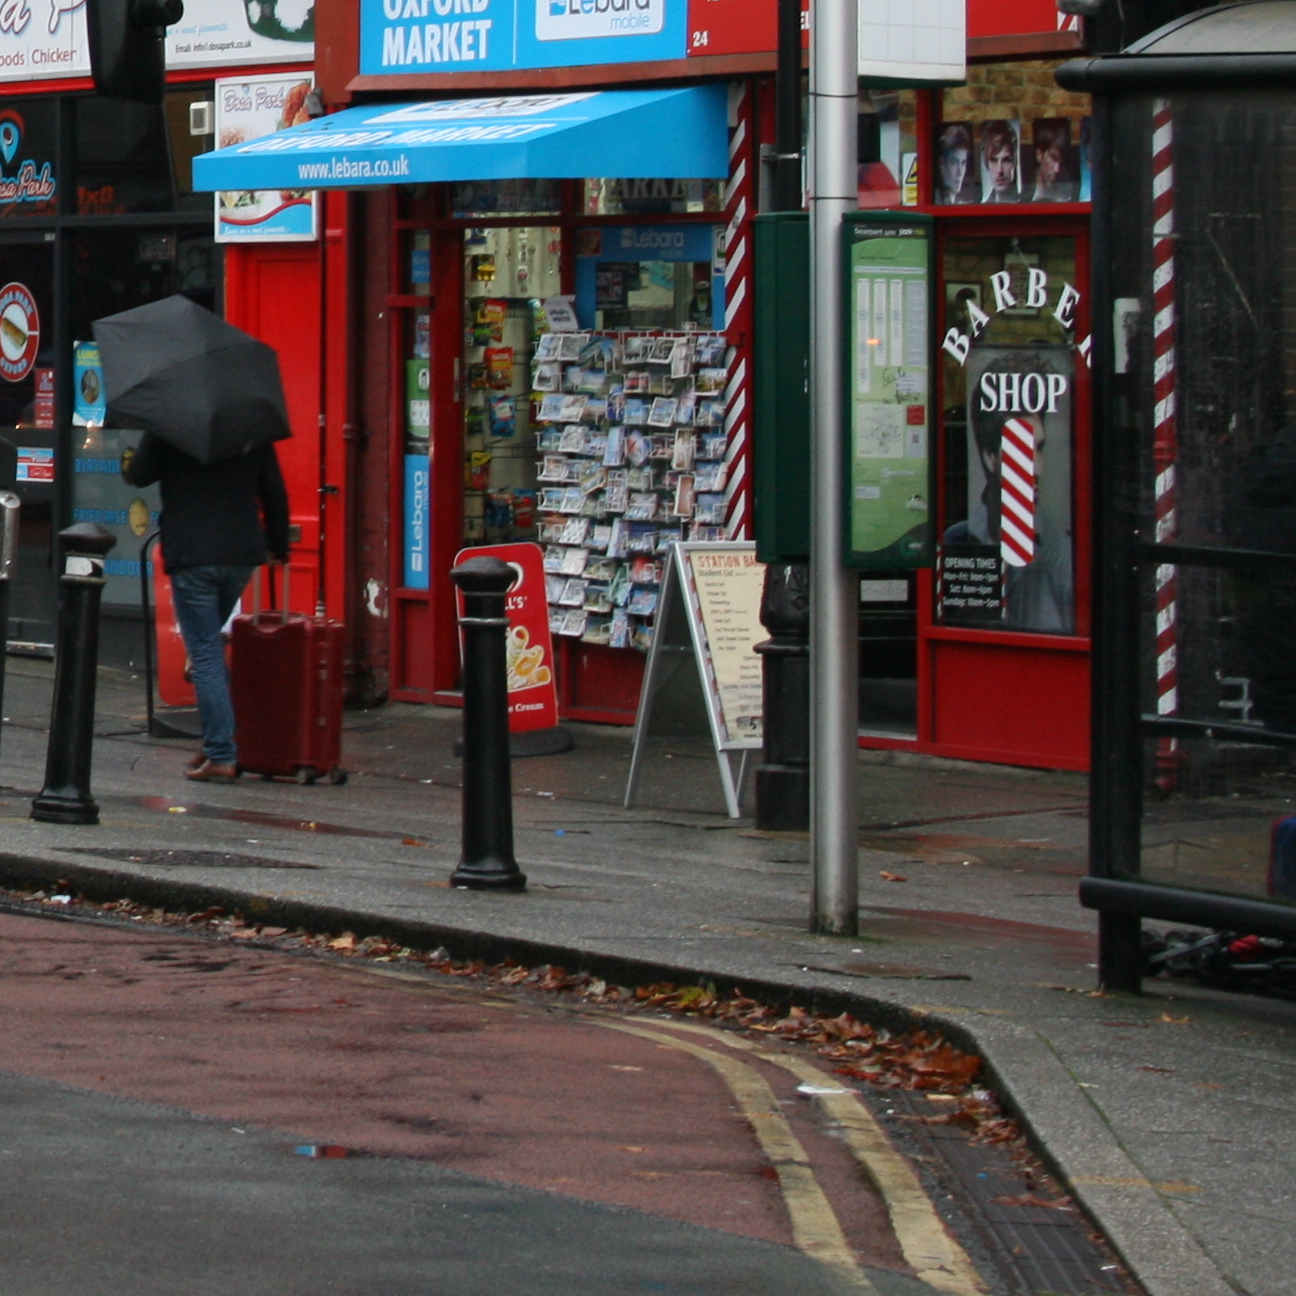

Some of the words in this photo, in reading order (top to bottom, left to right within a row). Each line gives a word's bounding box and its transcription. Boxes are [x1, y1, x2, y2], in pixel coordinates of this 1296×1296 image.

[609, 14, 651, 30] mobile
[381, 19, 493, 66] MARKET
[692, 30, 709, 46] 24
[380, 122, 558, 146] MARKET
[16, 159, 56, 198] Park
[297, 153, 409, 180] www.lebara.co.uk
[633, 228, 684, 248] Lebara
[979, 371, 1068, 414] SHOP
[412, 470, 424, 552] Lebara
[698, 555, 740, 568] STATION
[944, 557, 975, 569] OPENING
[975, 557, 996, 570] TIMES
